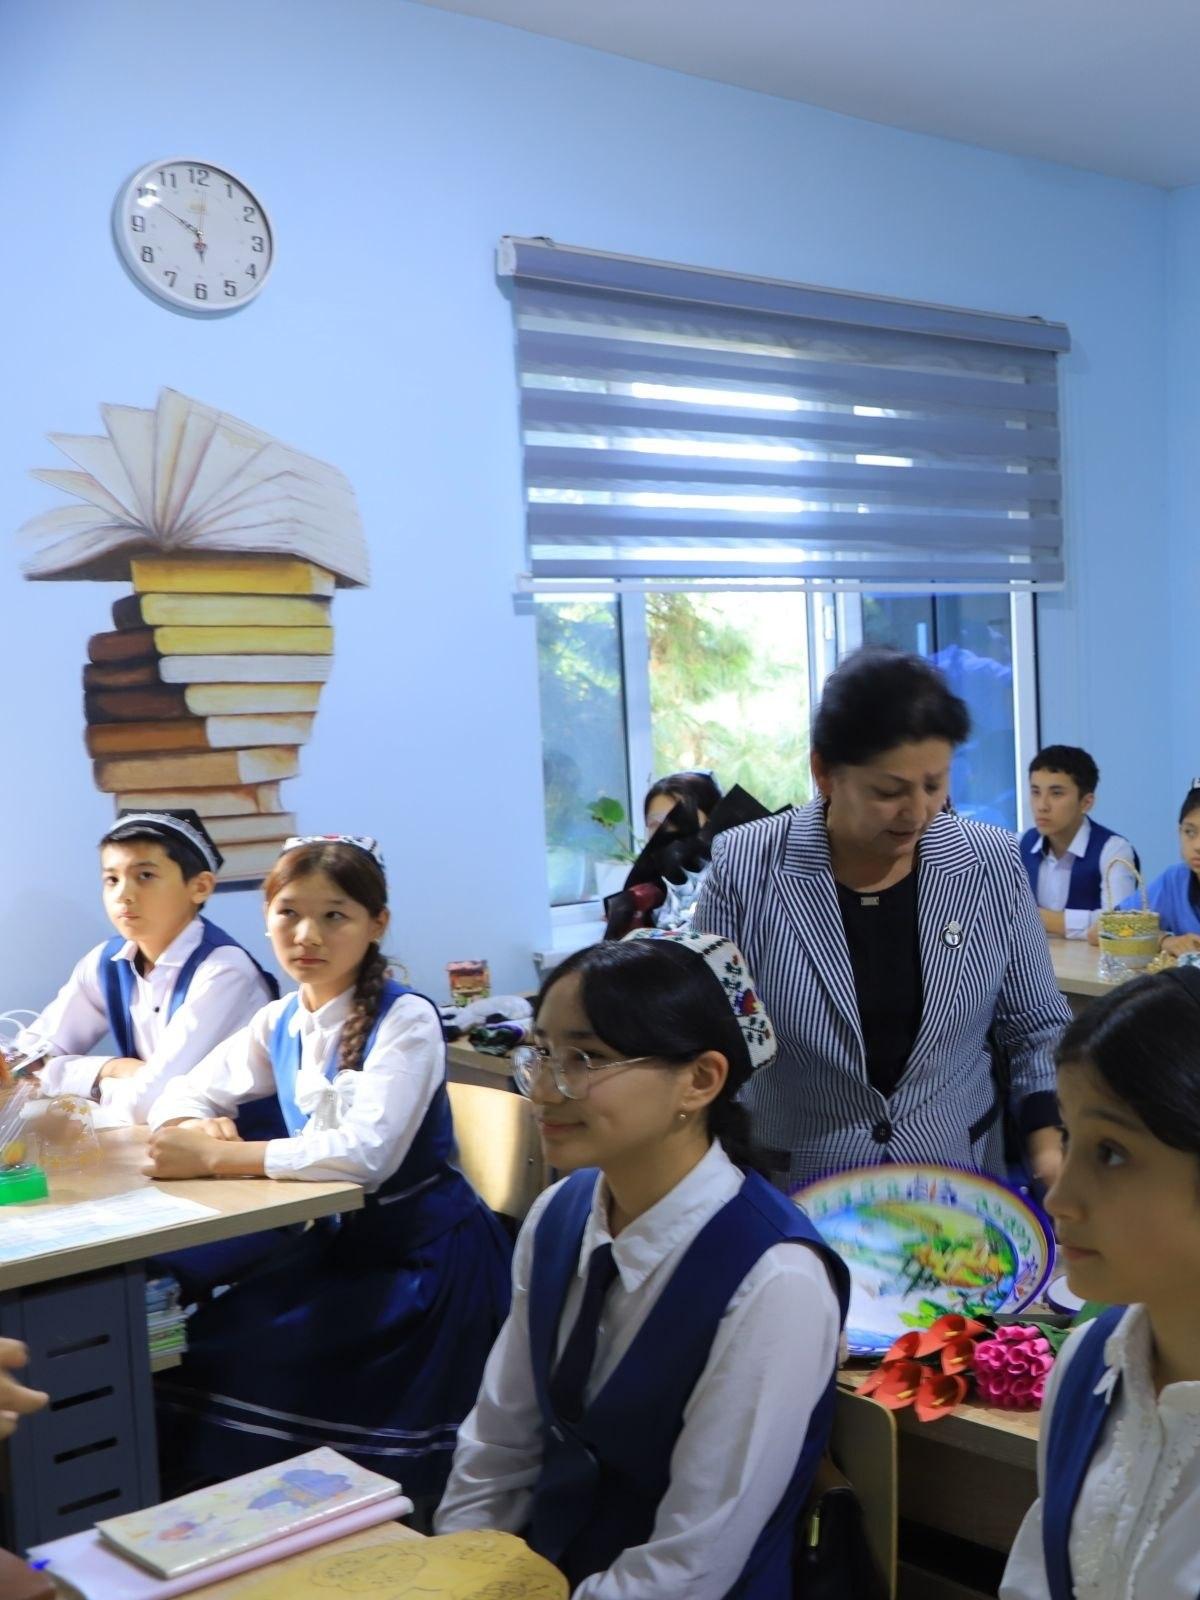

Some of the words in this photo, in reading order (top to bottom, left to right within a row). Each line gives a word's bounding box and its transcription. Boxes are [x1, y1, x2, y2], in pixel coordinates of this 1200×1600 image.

[158, 171, 177, 188] 11
[187, 168, 210, 187] 12
[224, 184, 233, 199] 1
[243, 206, 255, 223] 2
[131, 215, 145, 233] 9
[251, 235, 265, 253] 3
[141, 246, 154, 263] 8
[164, 270, 178, 288] 7
[245, 263, 257, 279] 4
[194, 283, 208, 300] 6
[224, 280, 236, 297] 5
